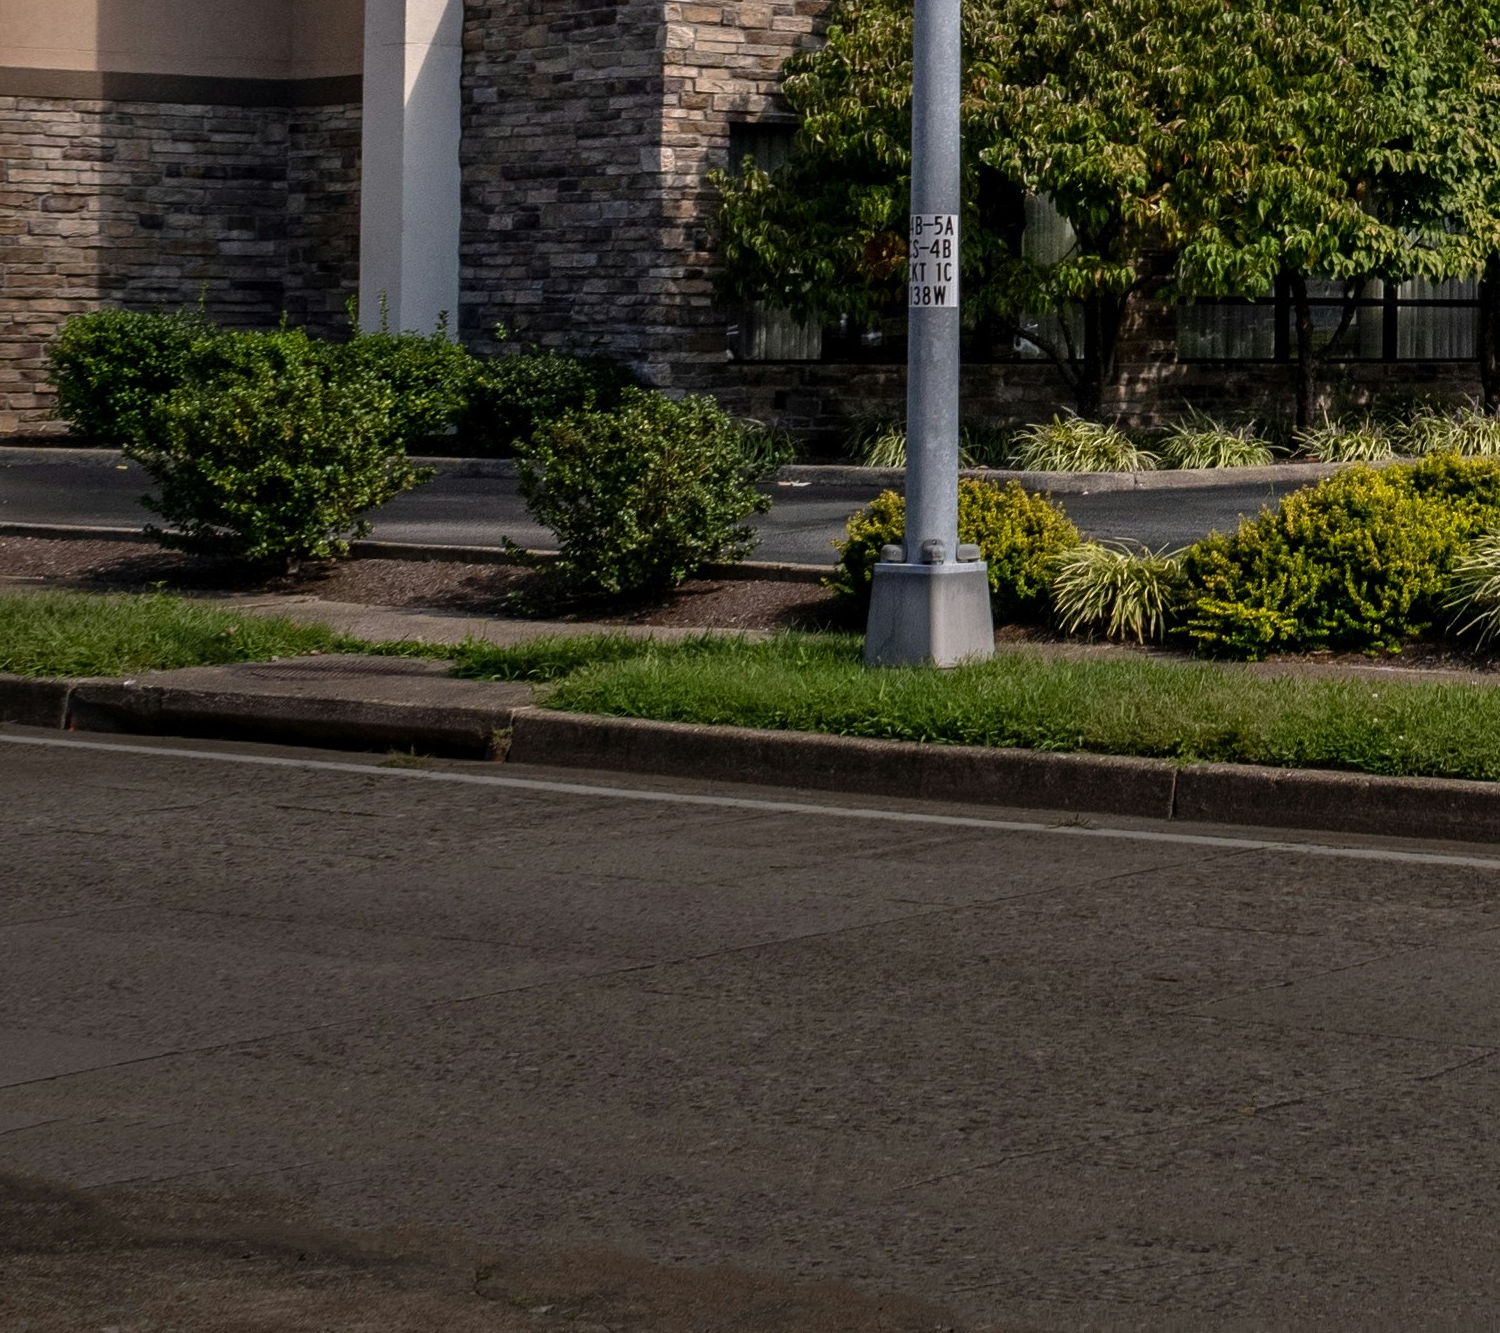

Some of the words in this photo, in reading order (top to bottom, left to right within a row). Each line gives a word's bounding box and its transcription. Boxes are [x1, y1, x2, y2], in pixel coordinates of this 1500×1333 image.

[909, 238, 952, 259] S-4B
[909, 262, 927, 282] KT
[936, 261, 953, 282] 1C
